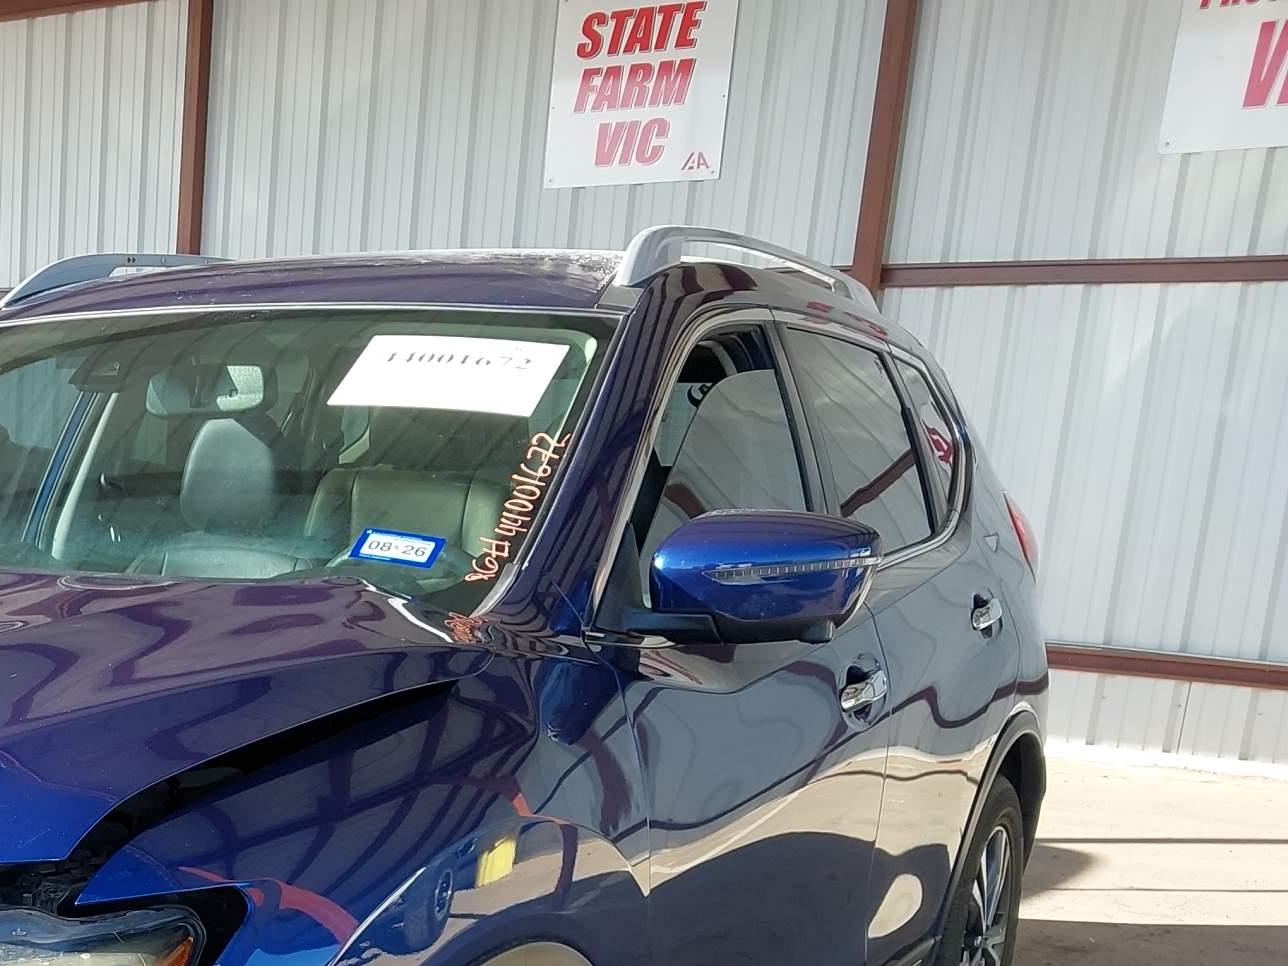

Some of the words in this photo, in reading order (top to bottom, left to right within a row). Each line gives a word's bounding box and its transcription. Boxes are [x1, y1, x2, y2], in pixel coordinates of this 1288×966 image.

[575, 0, 708, 60] STATE
[573, 57, 698, 114] FARM
[594, 117, 671, 168] VIC
